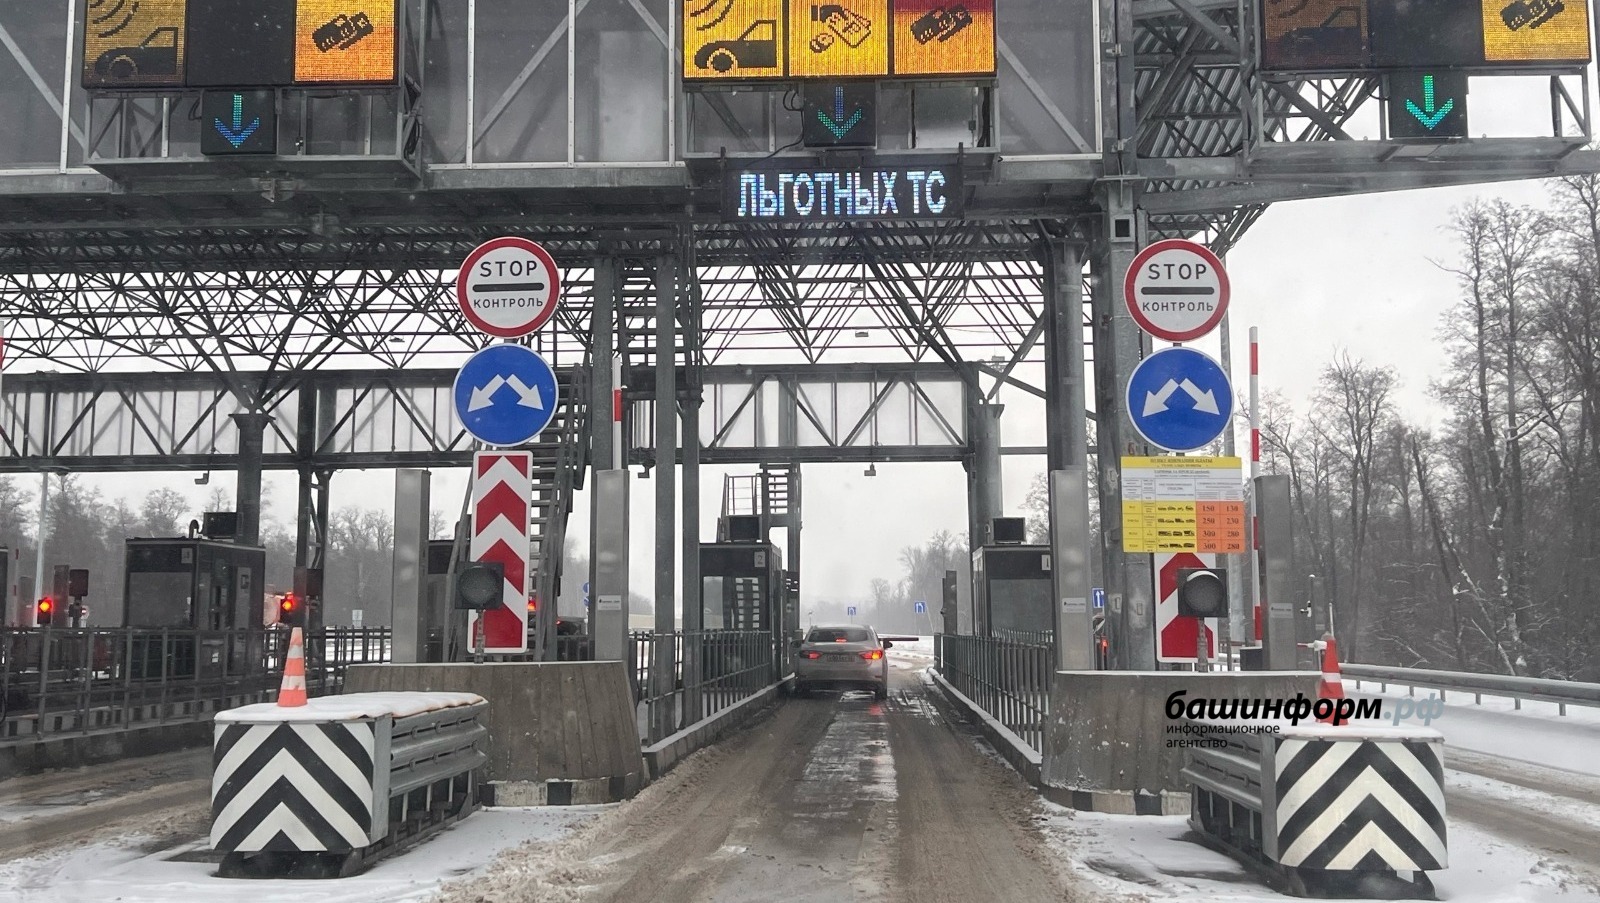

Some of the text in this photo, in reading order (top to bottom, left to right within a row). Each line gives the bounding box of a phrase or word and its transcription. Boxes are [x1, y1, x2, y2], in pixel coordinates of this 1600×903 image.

[737, 170, 946, 217] ЛЬГОТНЫХ ТС
[480, 260, 537, 277] STOP
[1148, 263, 1207, 280] STOP
[473, 297, 544, 308] КОНТРОЛЬ
[1142, 302, 1214, 312] КОНТРОЛЬ
[757, 554, 763, 565] 2
